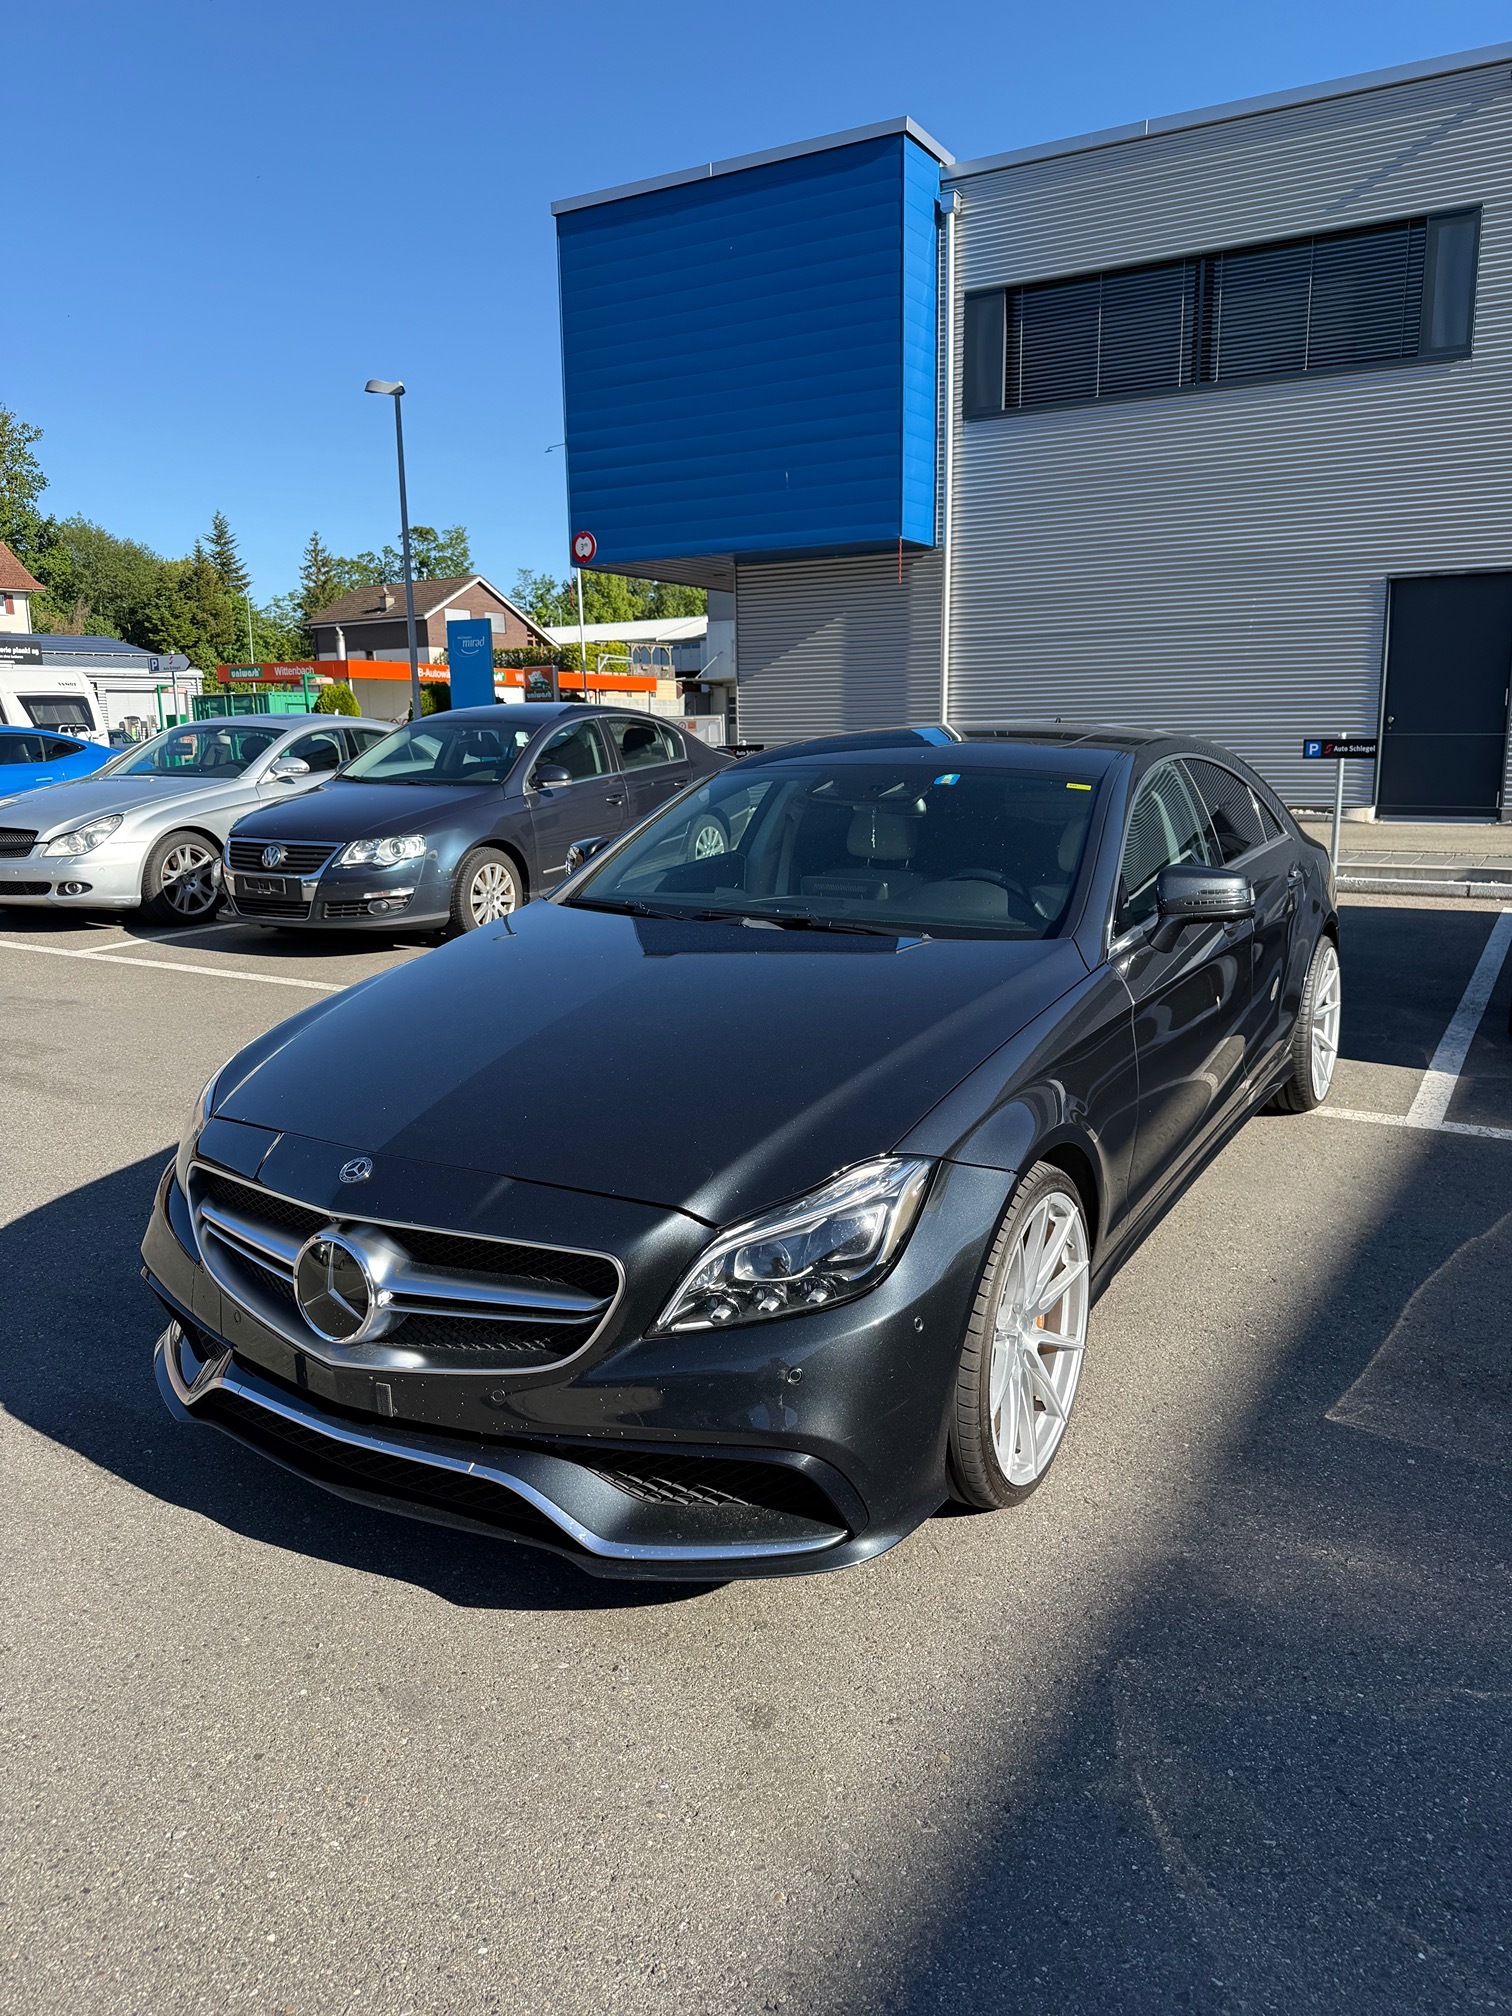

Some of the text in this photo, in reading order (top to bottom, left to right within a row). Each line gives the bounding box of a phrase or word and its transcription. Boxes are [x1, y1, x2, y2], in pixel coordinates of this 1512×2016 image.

[462, 635, 485, 648] mirad
[151, 659, 158, 671] P
[231, 665, 315, 678] uniwash Wittenbach
[1309, 743, 1319, 755] P
[1349, 745, 1376, 753] Schlegel
